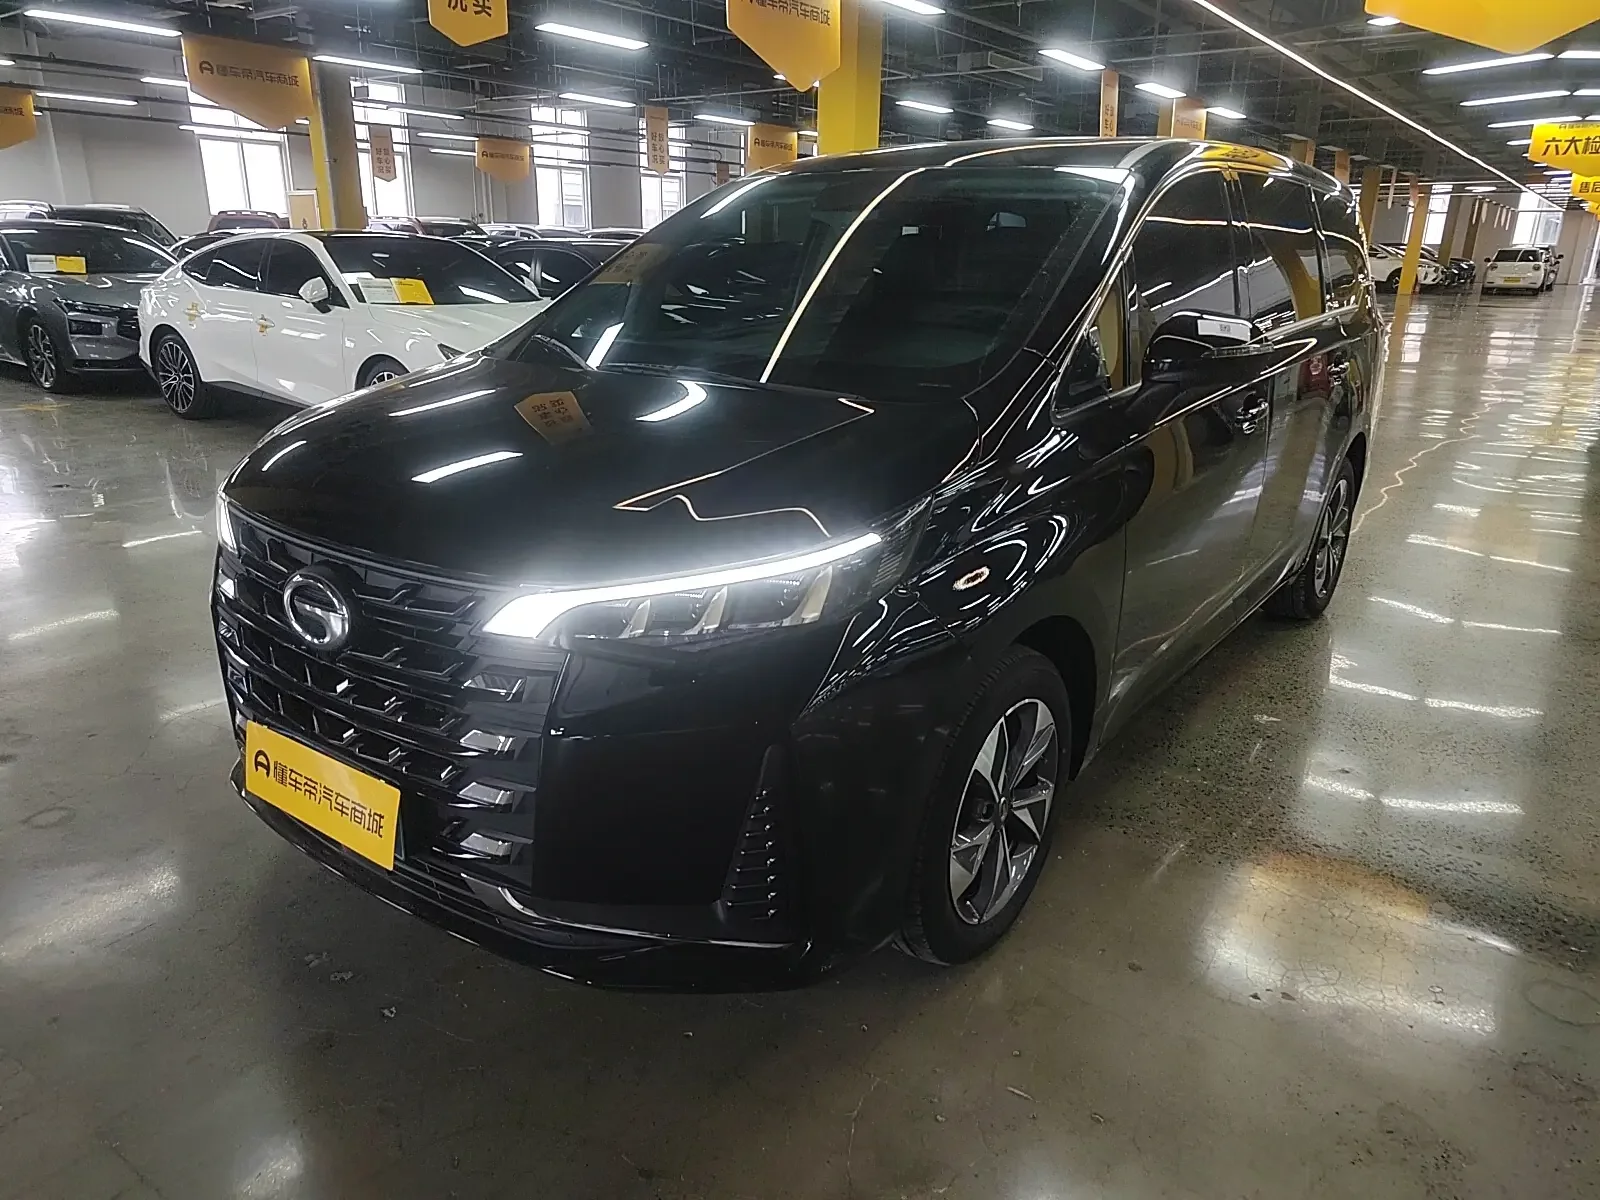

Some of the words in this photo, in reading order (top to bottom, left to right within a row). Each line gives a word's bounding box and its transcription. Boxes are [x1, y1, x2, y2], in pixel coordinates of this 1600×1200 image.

[1541, 136, 1600, 156] 六大检
[273, 760, 385, 839] 懂车帝汽车商城
